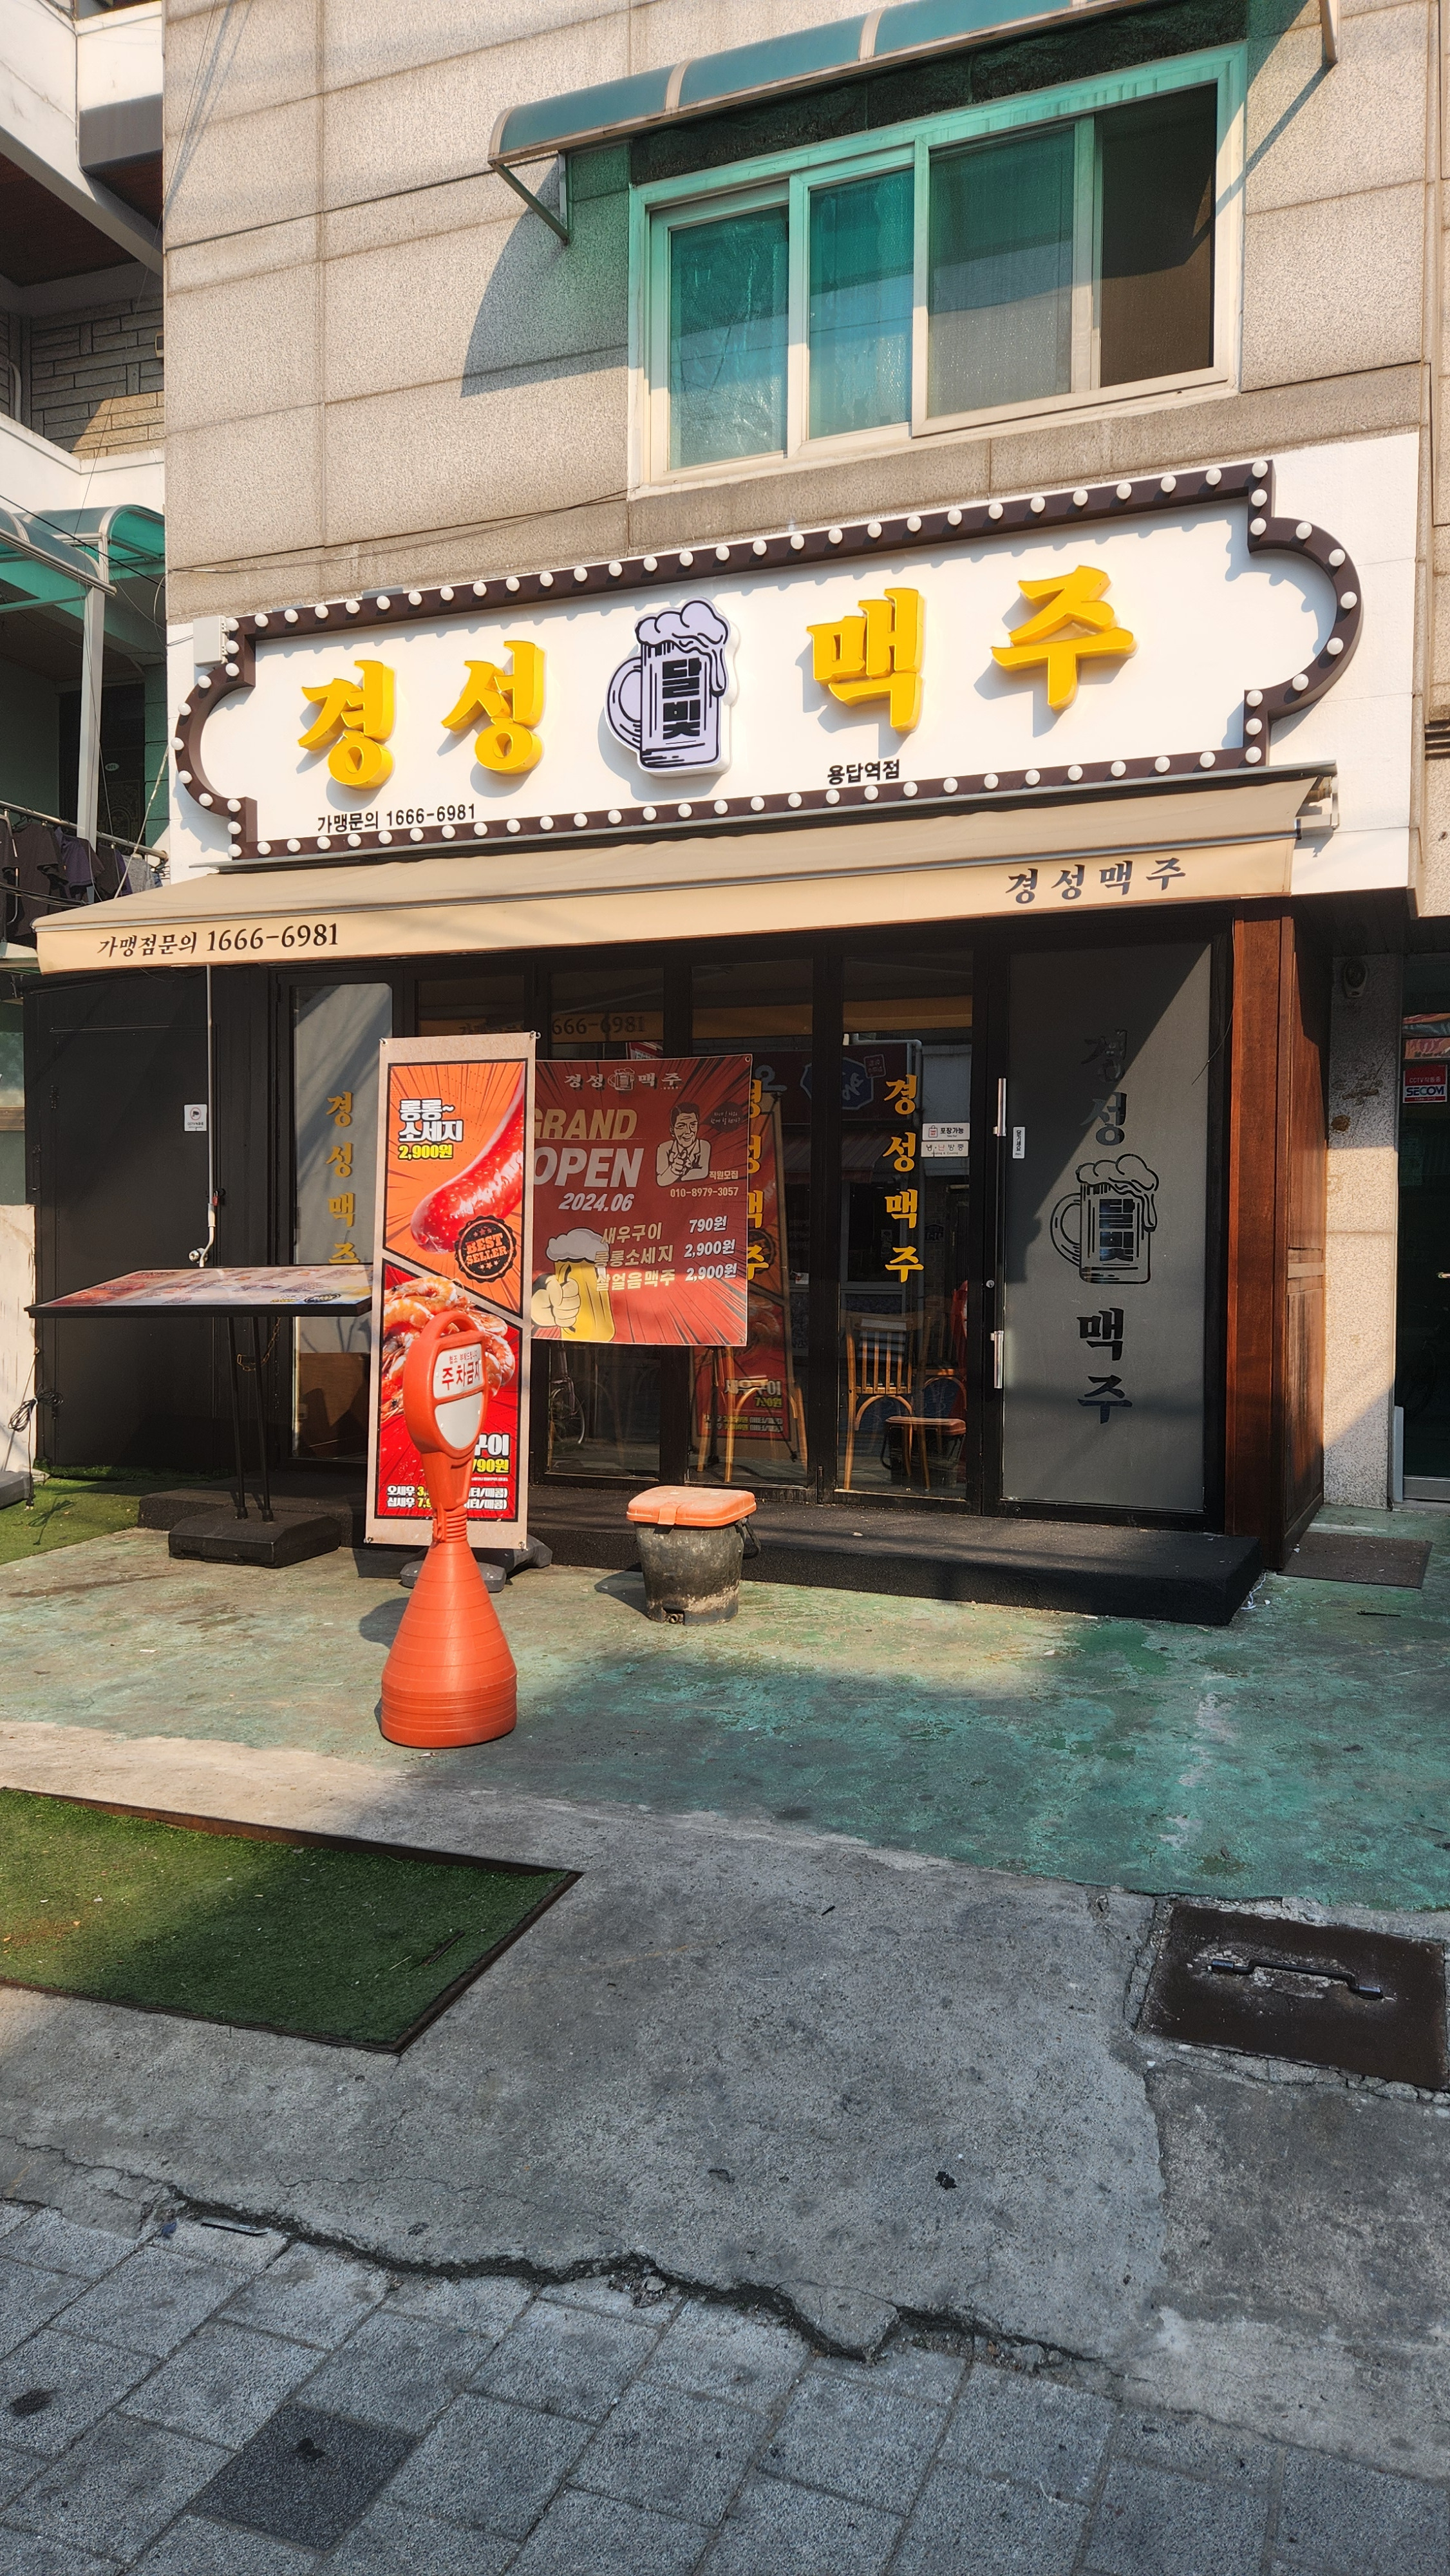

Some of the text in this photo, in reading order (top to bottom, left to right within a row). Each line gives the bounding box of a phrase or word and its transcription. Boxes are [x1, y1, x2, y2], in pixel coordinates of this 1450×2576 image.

[663, 658, 702, 740] 달빛
[827, 759, 899, 785] 용답역점
[317, 803, 475, 833] 가맹문의 1666-6981
[97, 923, 339, 958] 가맹점문의 1666-6981
[552, 1016, 645, 1035] 666-6981
[1406, 1086, 1444, 1096] SECOM
[398, 1119, 464, 1142] 소세지
[398, 1144, 453, 1160] 2,900원
[534, 1146, 645, 1188] OPEN
[709, 1170, 739, 1180] 직원모집
[558, 1193, 635, 1212] 2024.06
[670, 1186, 739, 1198] 010-8979-3057
[601, 1215, 728, 1245] 새우구이 790원
[466, 1233, 504, 1255] BEST
[594, 1239, 737, 1269] 롱롱소세지 2,900원
[466, 1245, 508, 1266] SELLER
[595, 1263, 738, 1293] 살얼음맥주 2,900원
[442, 1358, 480, 1391] 주차금지
[474, 1434, 510, 1456] 구이
[387, 1485, 416, 1497] 오새우
[387, 1497, 416, 1508] 십새우
